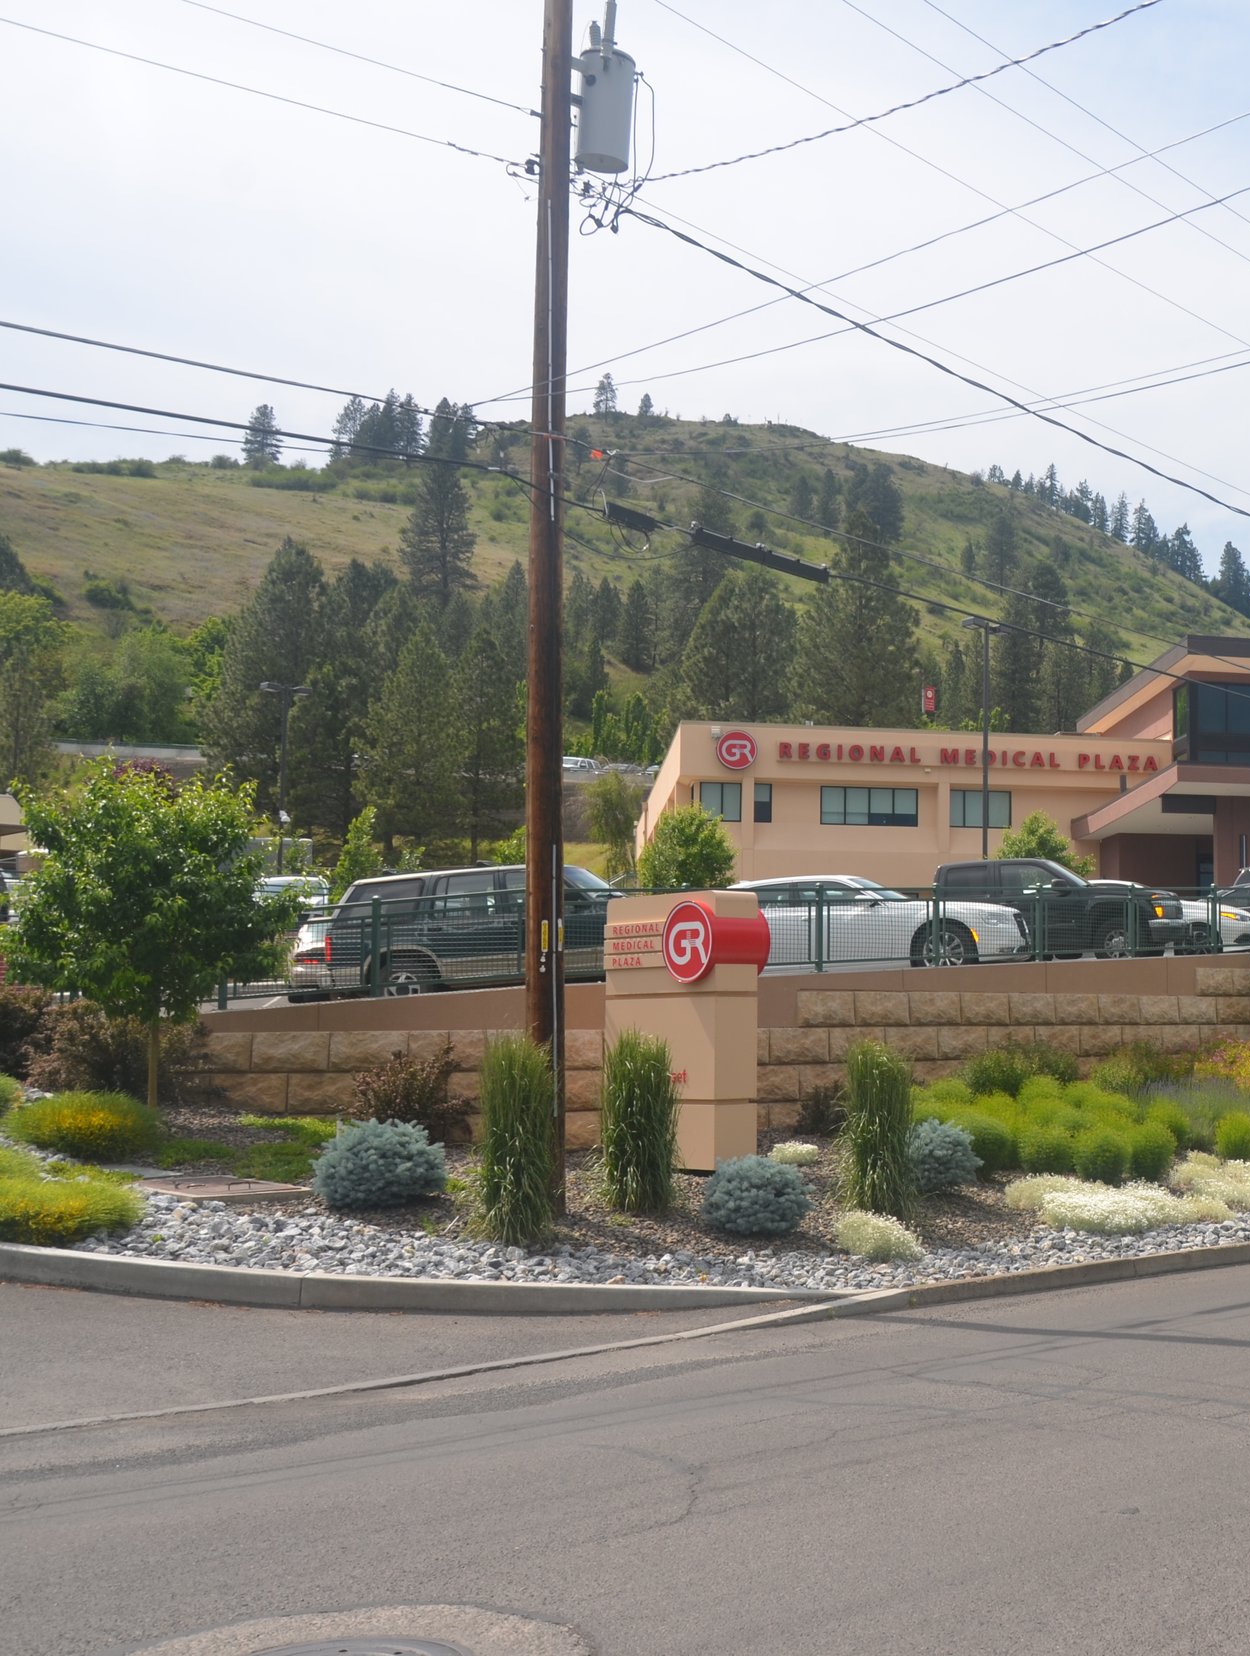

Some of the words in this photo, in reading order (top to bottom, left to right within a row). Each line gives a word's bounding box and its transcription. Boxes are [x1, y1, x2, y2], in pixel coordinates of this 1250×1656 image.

[721, 739, 753, 762] GR
[778, 741, 921, 763] REGIONAL
[940, 748, 1061, 768] MEDICAL
[1078, 753, 1158, 771] PLAZA
[613, 923, 660, 935] REGIONAL
[613, 940, 655, 951] MEDICAL
[669, 921, 707, 965] GR
[613, 957, 642, 968] PLAZA
